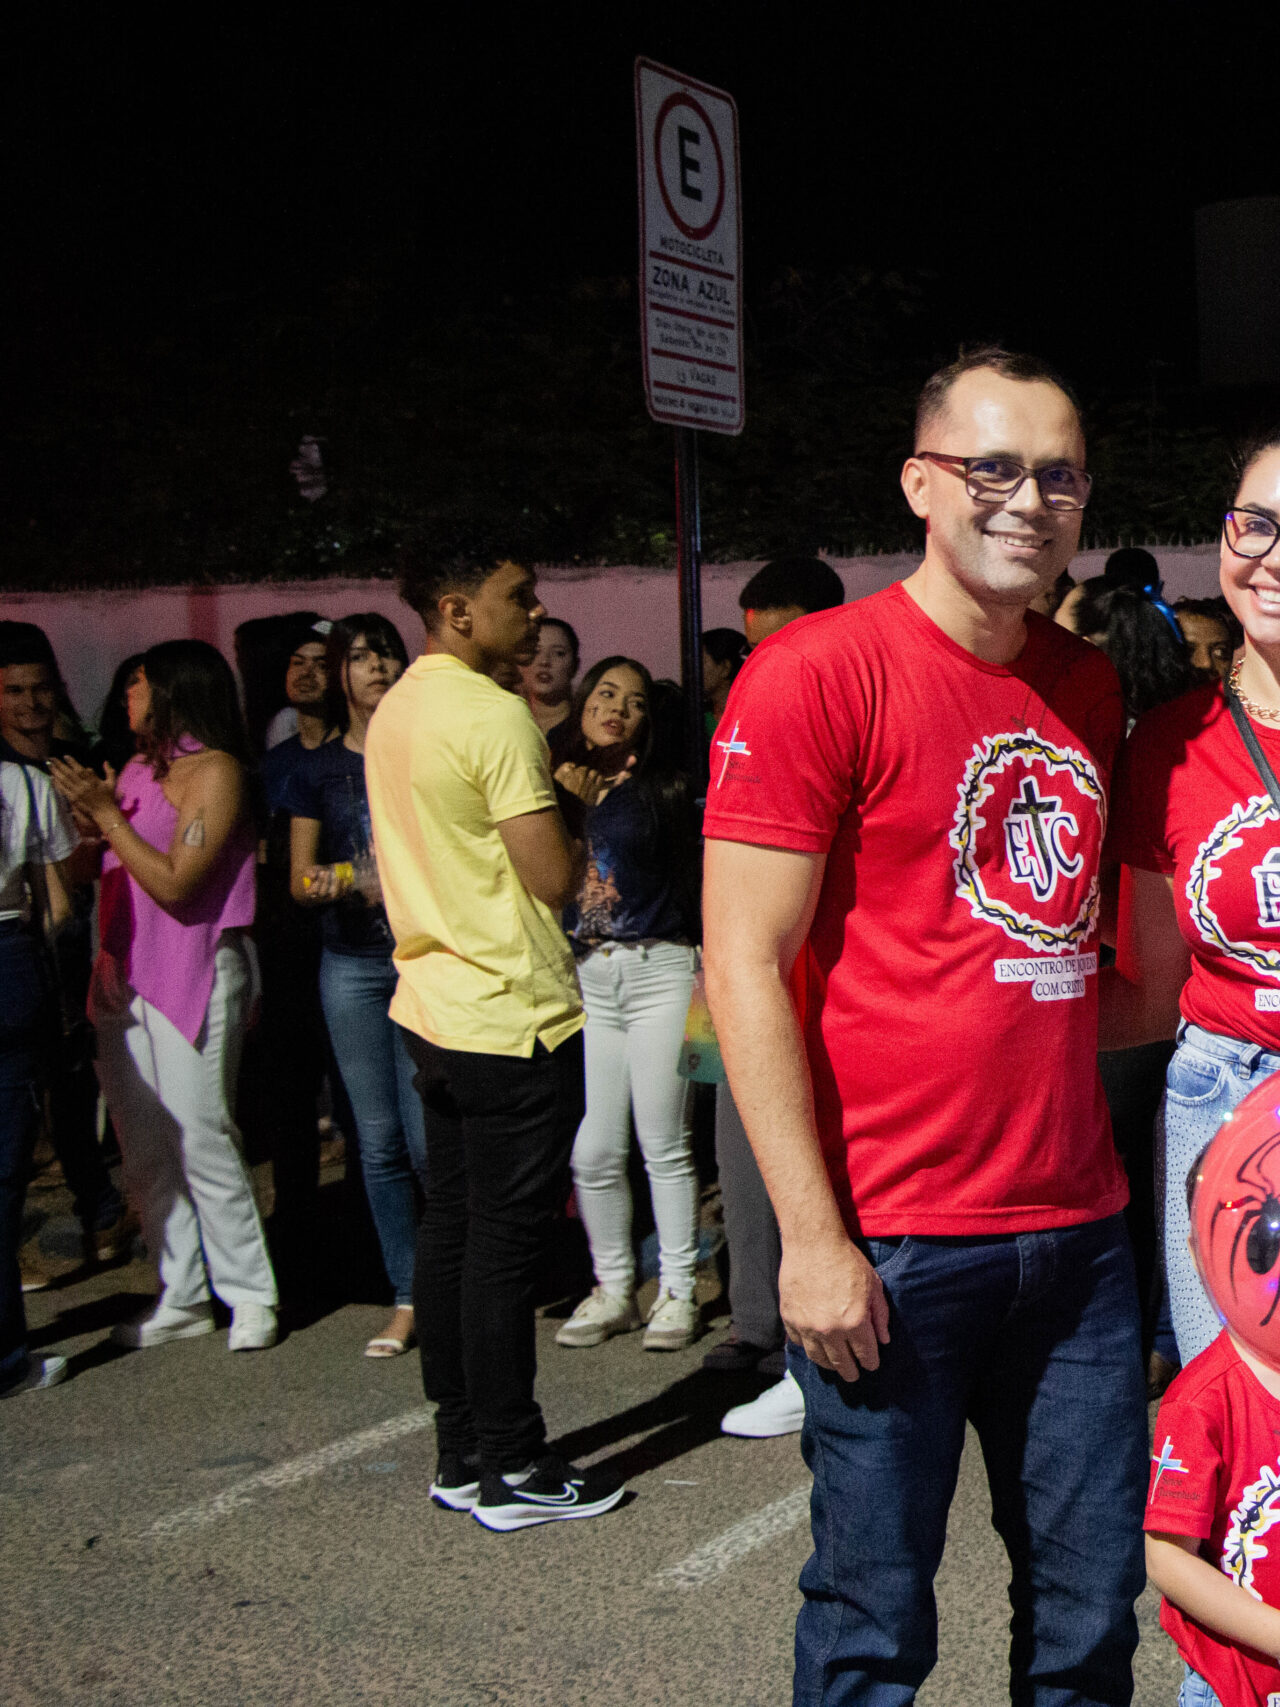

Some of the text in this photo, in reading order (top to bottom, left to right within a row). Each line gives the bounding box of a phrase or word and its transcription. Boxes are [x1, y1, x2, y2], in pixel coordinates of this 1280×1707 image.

[678, 126, 703, 202] E
[660, 237, 724, 265] MOTOCICLETA
[652, 266, 731, 306] ZONA AZUL
[690, 368, 718, 387] VAGAS
[1005, 779, 1081, 898] EJC
[1000, 962, 1063, 978] ENCONTRO
[1065, 960, 1076, 973] DE
[1035, 979, 1084, 996] COM CRISTO
